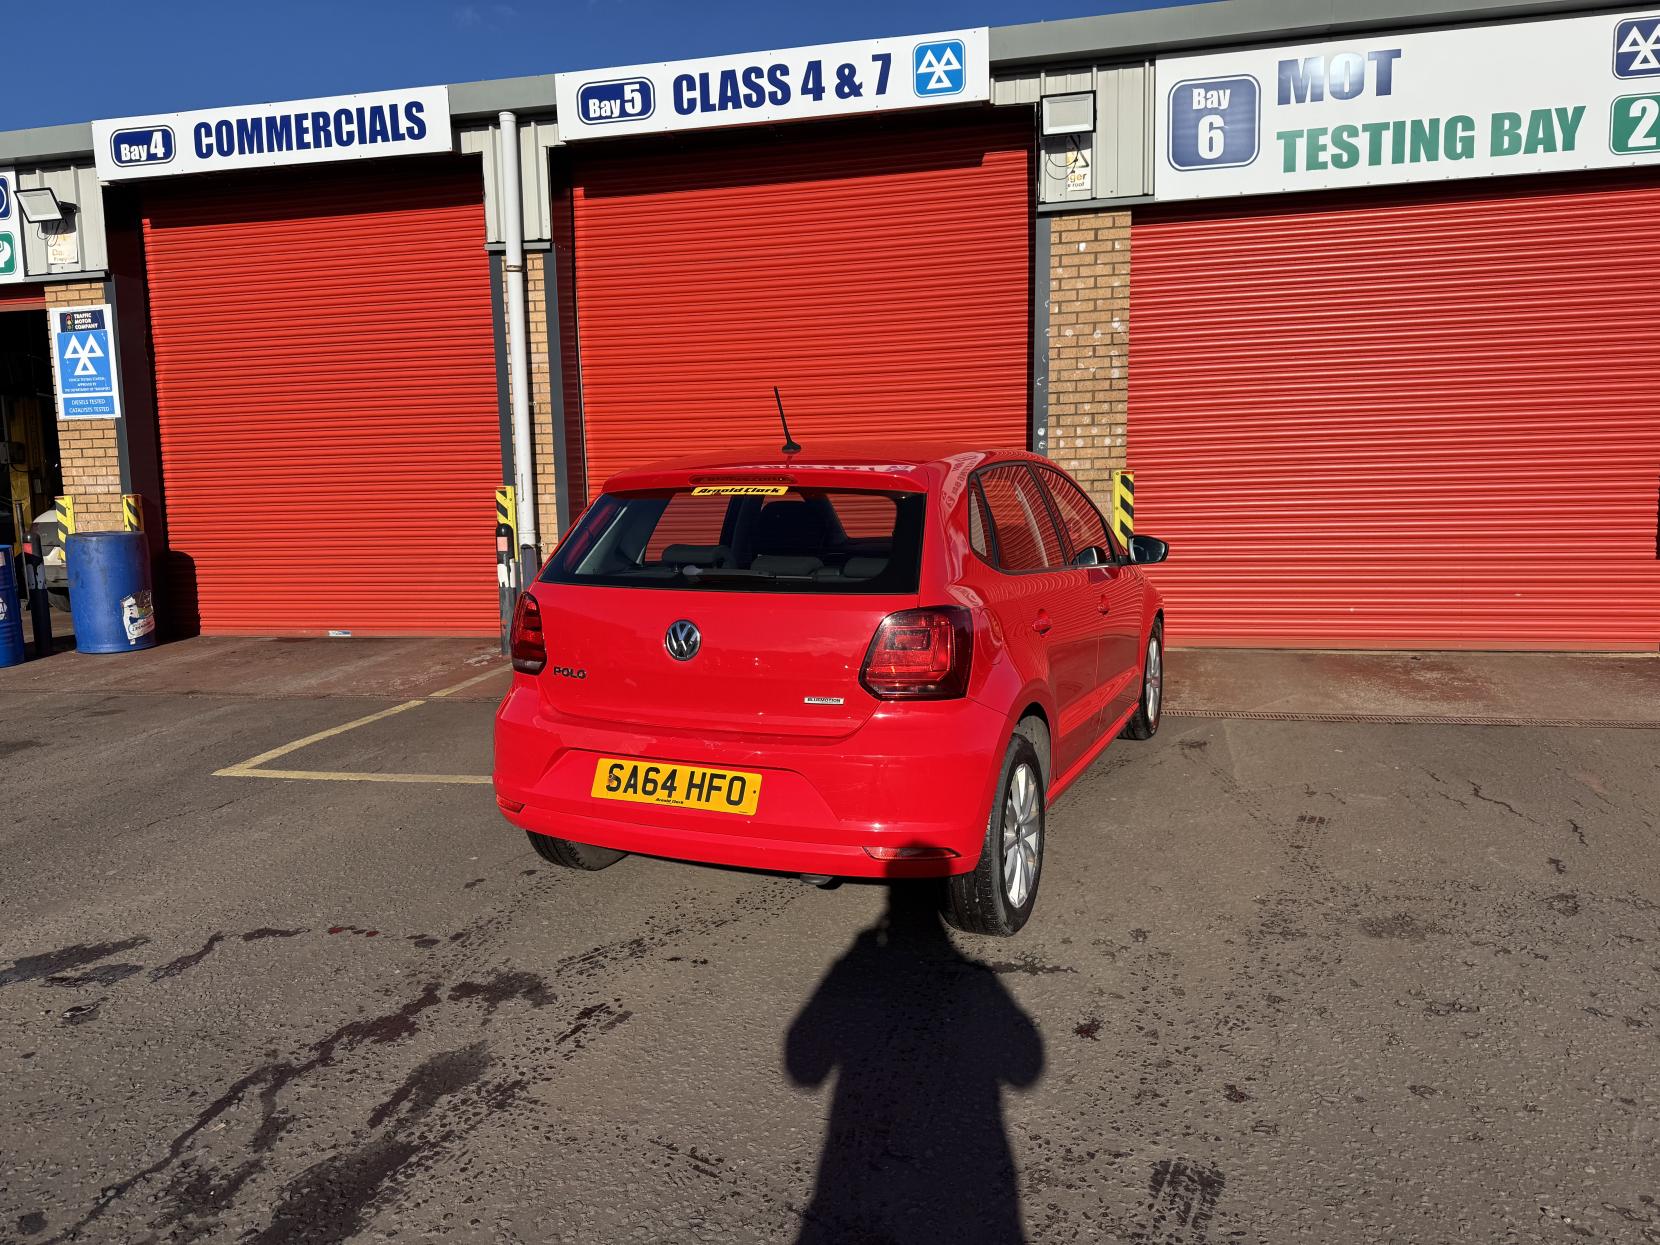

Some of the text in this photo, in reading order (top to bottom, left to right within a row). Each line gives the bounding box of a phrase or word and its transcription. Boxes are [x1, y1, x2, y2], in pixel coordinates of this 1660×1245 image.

[673, 53, 892, 116] CLASS 4 & 7
[1191, 86, 1231, 112] Bay
[1276, 48, 1402, 106] MOT
[588, 84, 643, 120] Bay 5
[1627, 98, 1660, 148] 2
[120, 130, 166, 163] Bay 4
[193, 100, 426, 160] COMMERCIALS
[1197, 114, 1226, 160] 6
[1276, 105, 1587, 174] TESTING BAY
[553, 666, 587, 679] POLO
[605, 763, 679, 798] SA64
